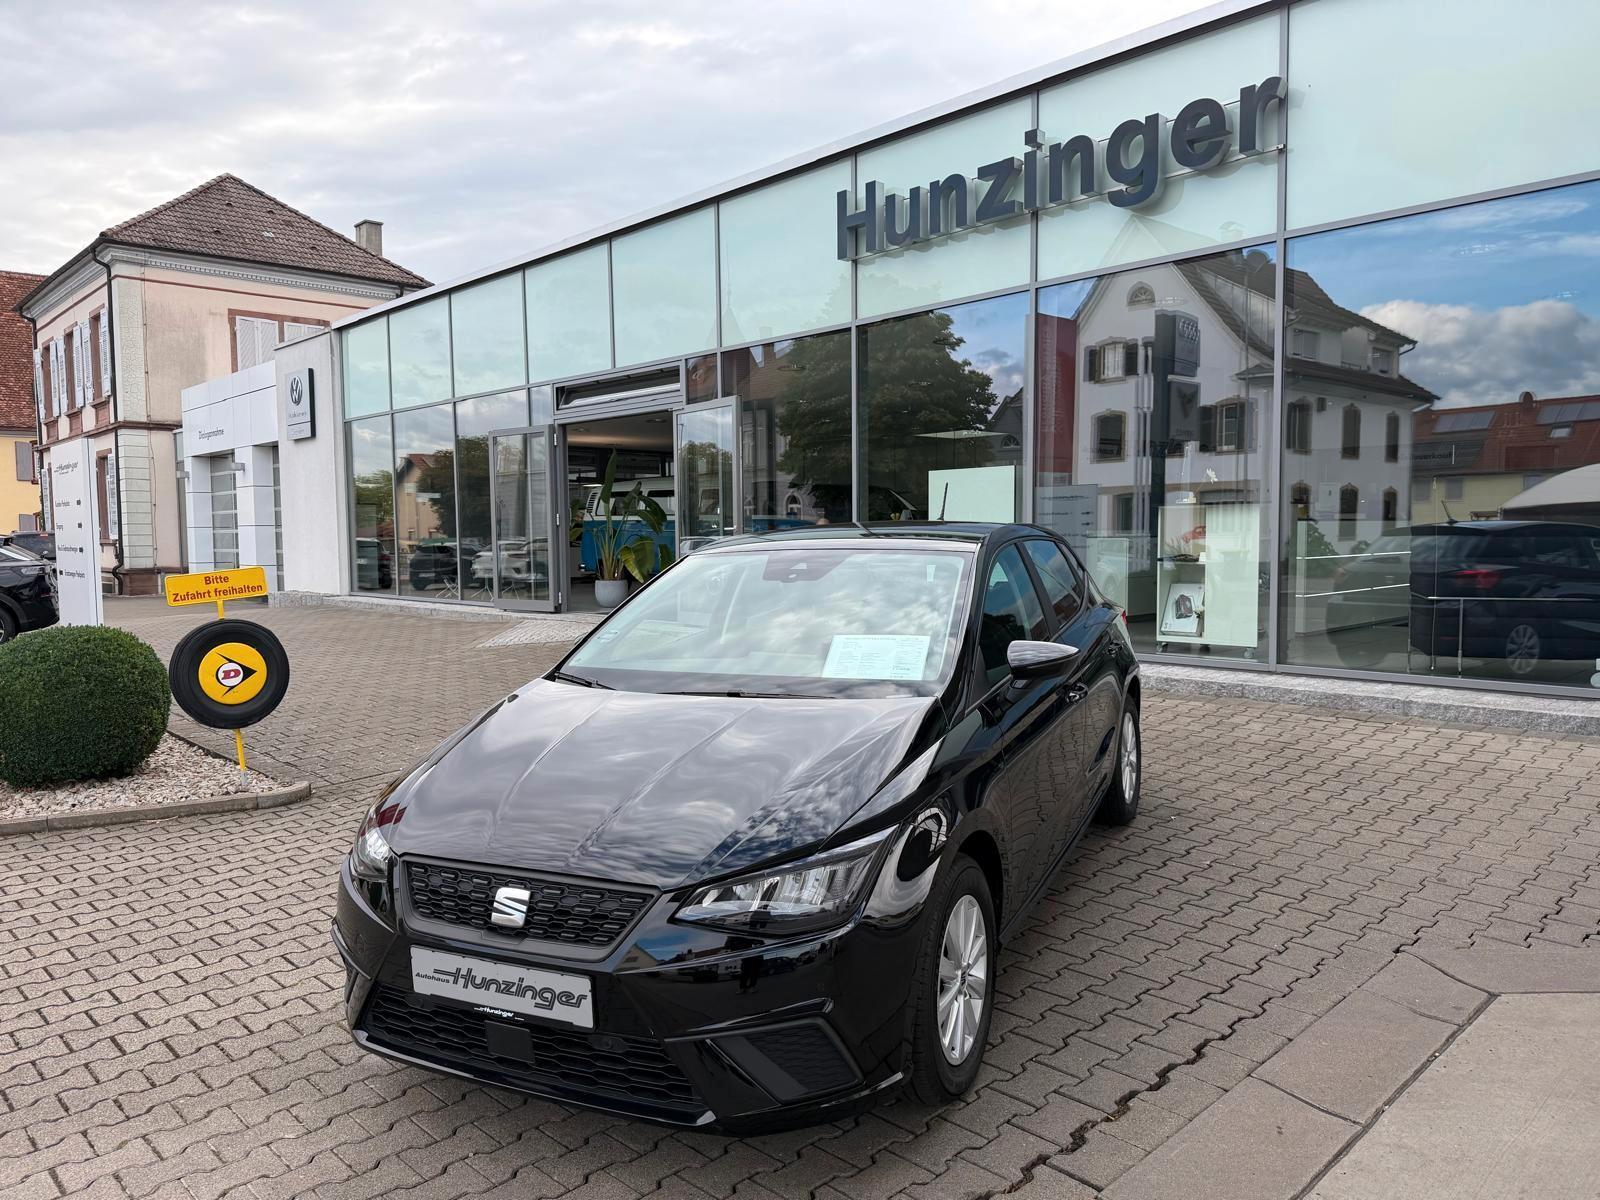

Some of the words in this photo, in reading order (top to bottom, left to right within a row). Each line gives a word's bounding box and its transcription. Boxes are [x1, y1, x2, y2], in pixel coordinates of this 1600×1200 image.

[837, 76, 1287, 262] Hunzinger
[204, 575, 230, 586] Bitte
[172, 589, 212, 603] Zufahrt
[214, 584, 263, 597] freihalten
[221, 668, 242, 681] D
[415, 971, 450, 984] Autohaus
[433, 967, 588, 1011] Hunzinger
[479, 1006, 514, 1018] Hunzinger
